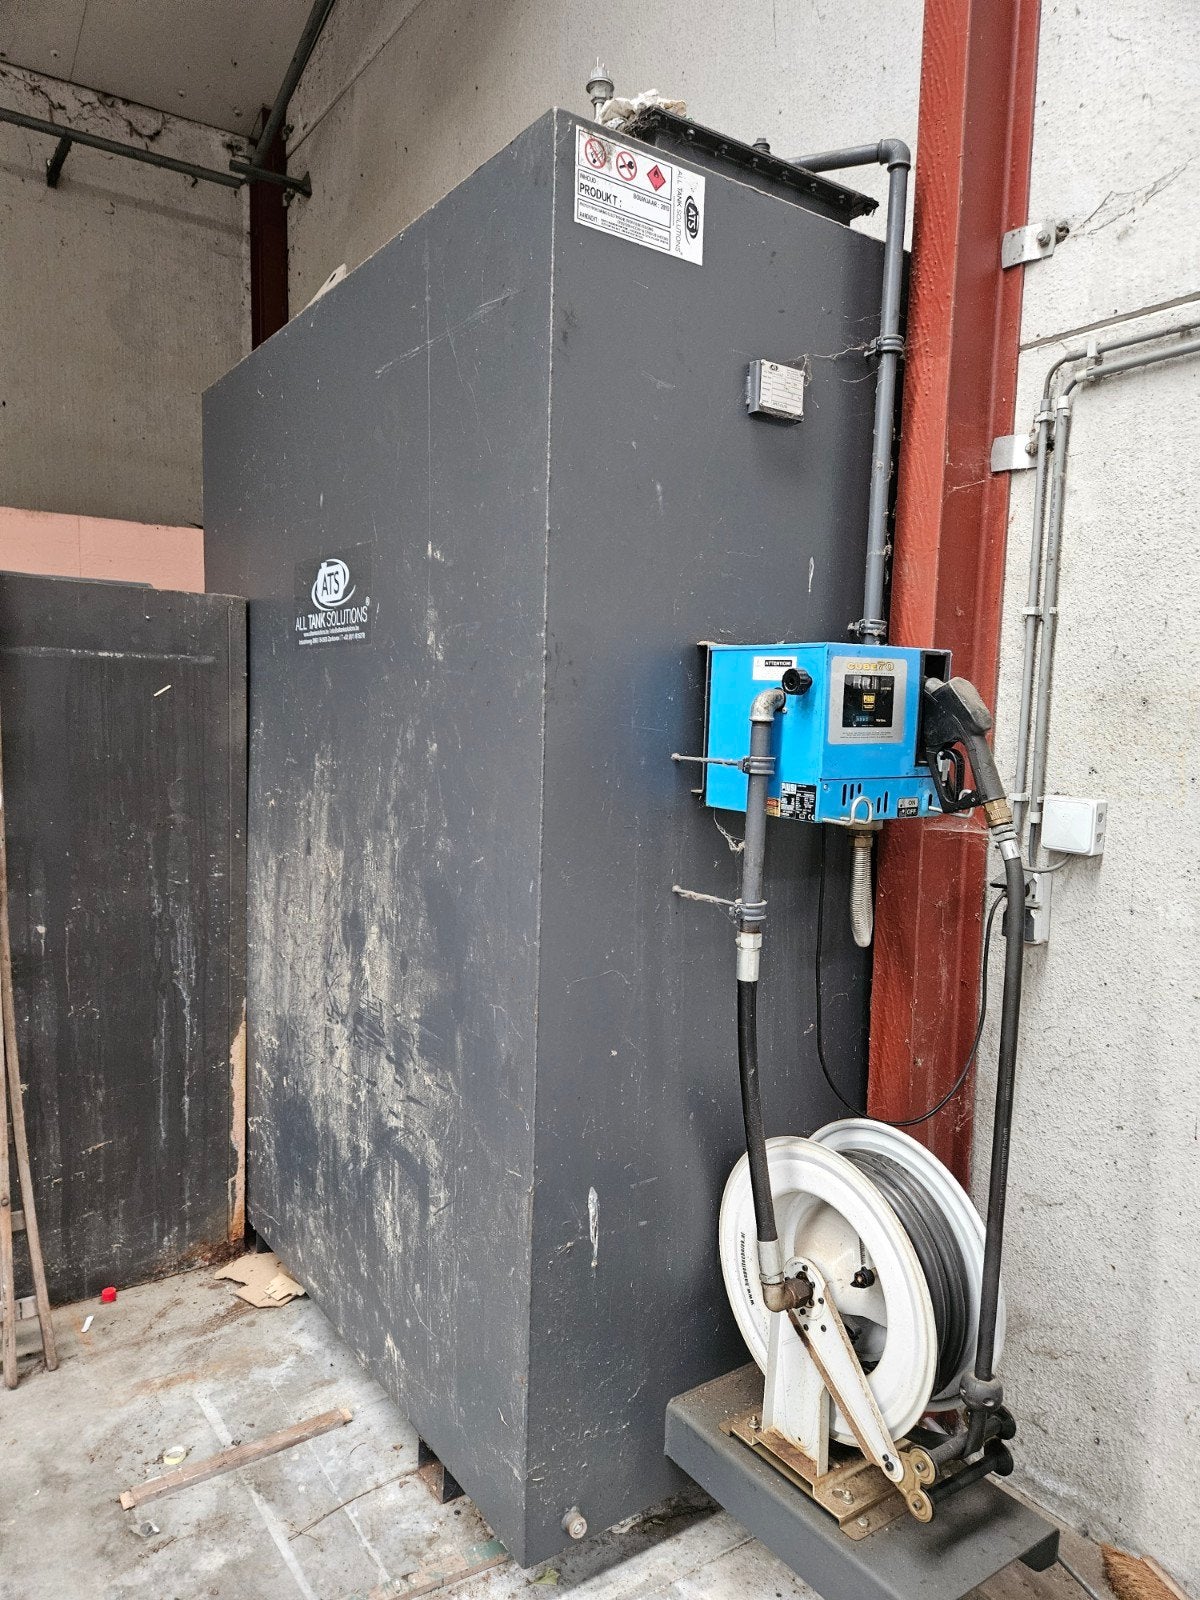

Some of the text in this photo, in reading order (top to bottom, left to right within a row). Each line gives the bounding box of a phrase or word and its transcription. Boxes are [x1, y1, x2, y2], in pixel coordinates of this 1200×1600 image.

[580, 183, 617, 205] PRODUKT
[687, 206, 697, 231] ATS
[320, 570, 340, 597] ATS
[295, 616, 307, 631] ALL
[307, 612, 327, 630] TANK
